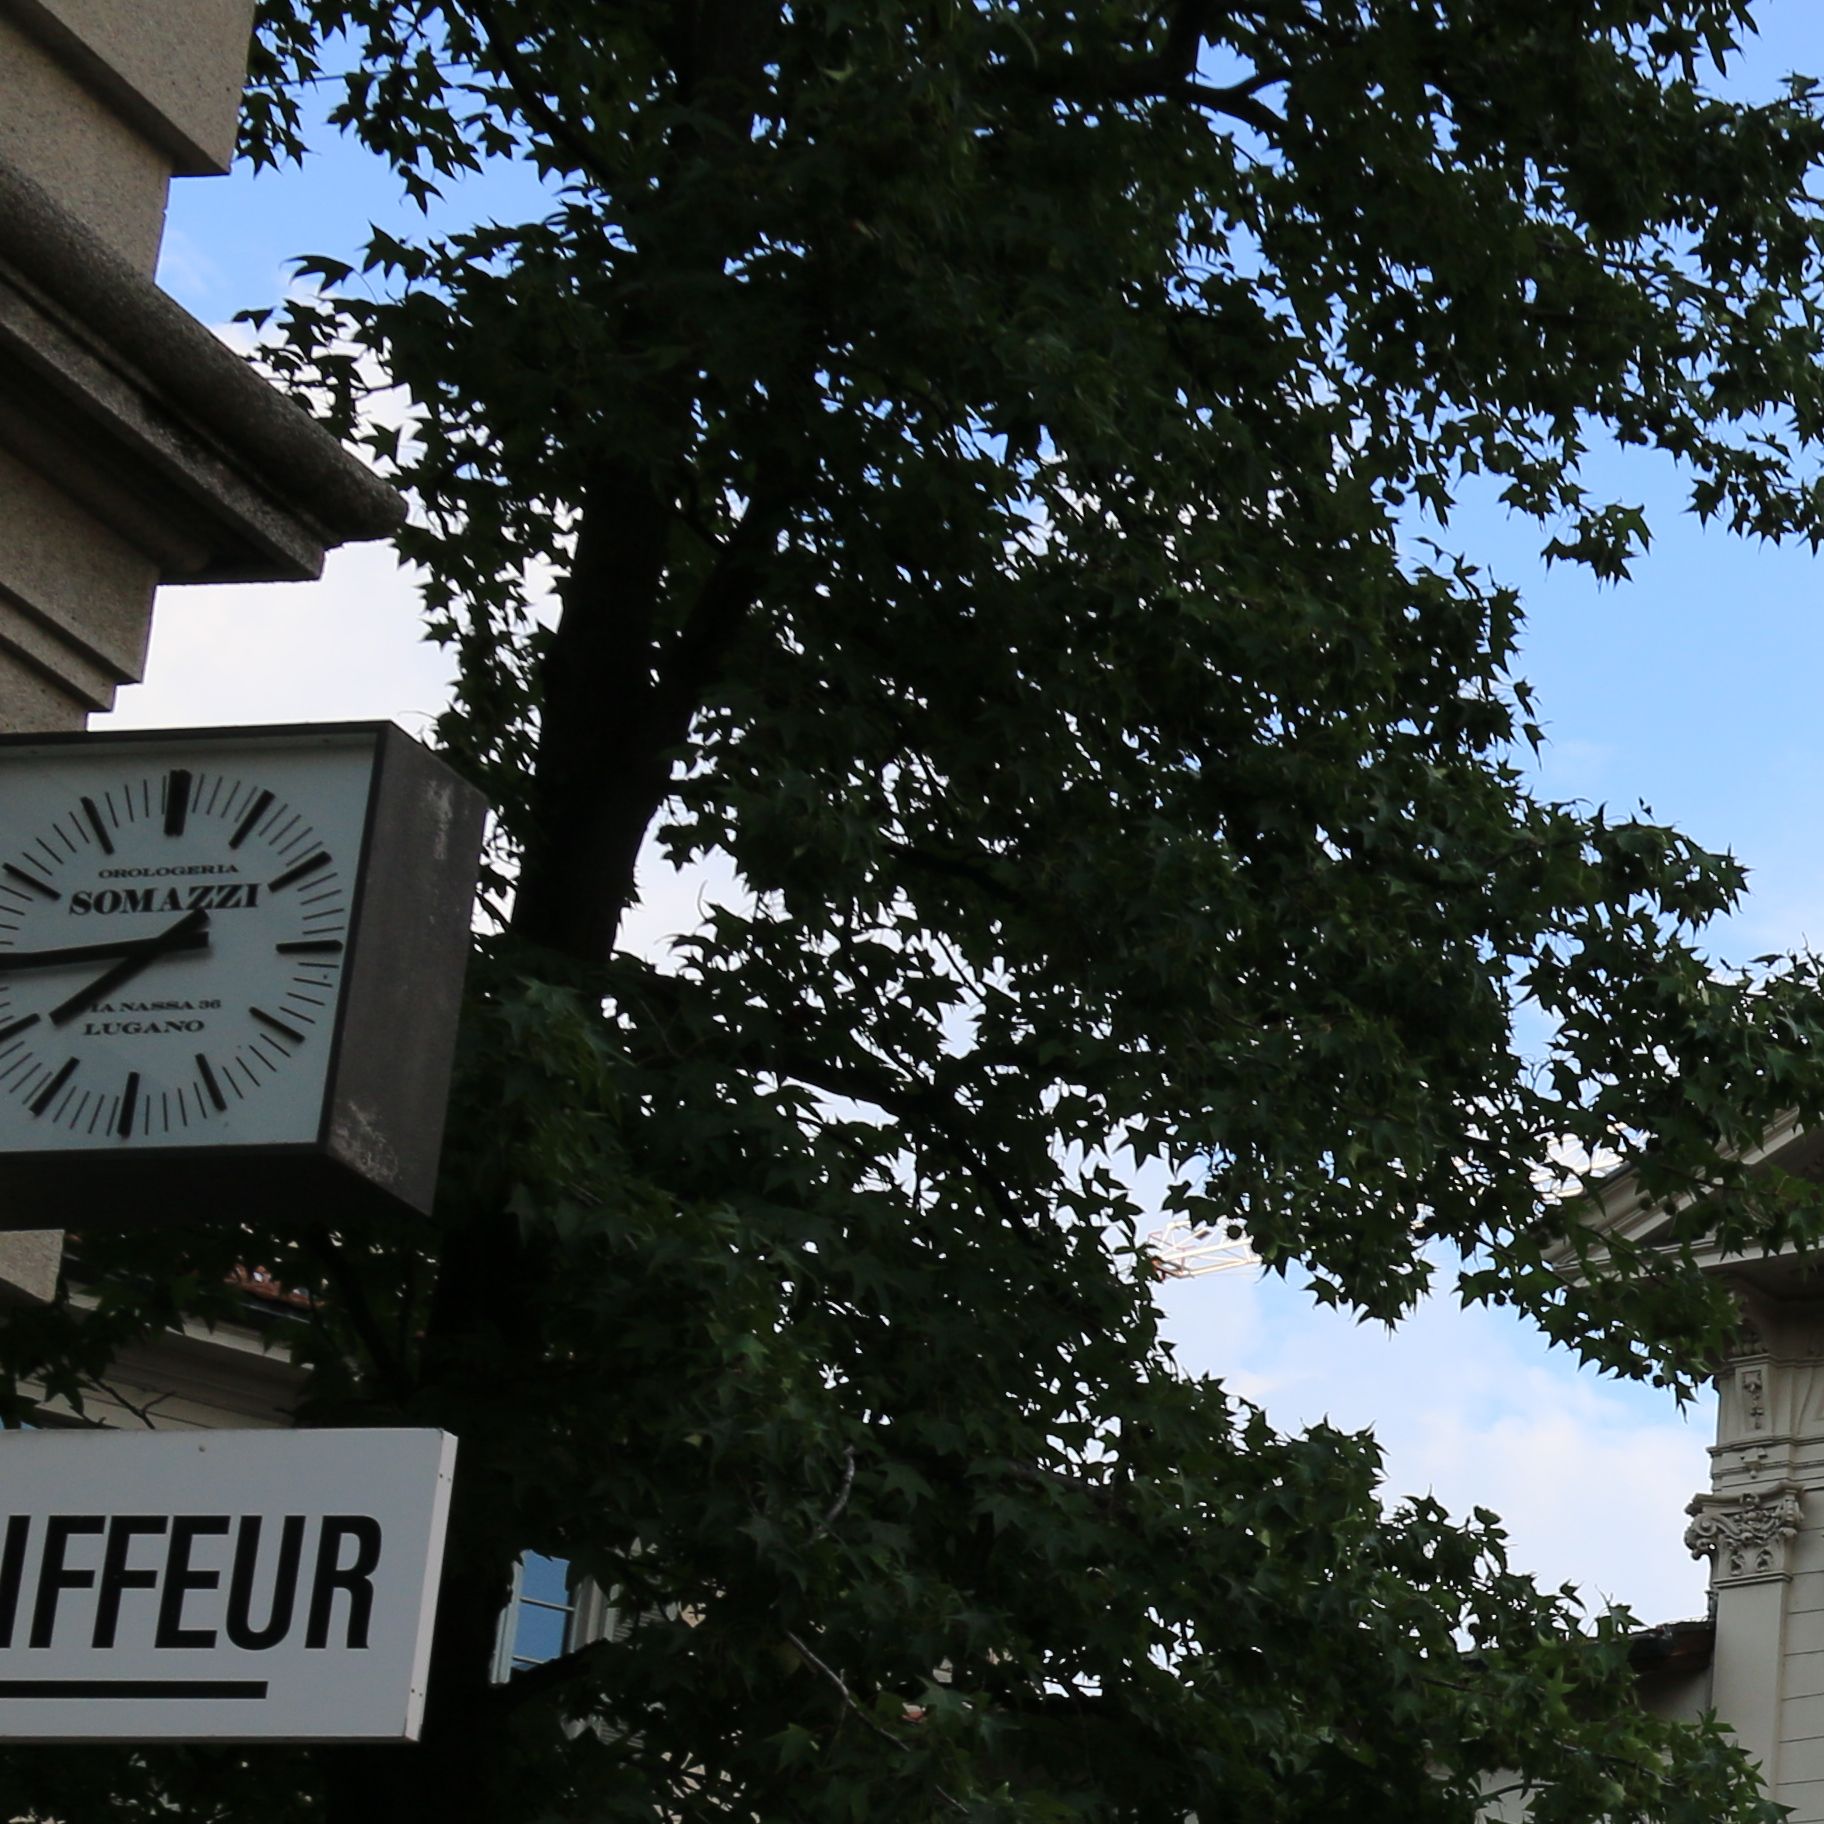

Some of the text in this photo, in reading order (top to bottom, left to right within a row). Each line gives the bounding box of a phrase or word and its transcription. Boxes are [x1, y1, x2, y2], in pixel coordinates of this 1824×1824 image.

[98, 864, 240, 879] OROLOGERIA
[68, 883, 261, 916] SOMAZZI
[86, 999, 222, 1013] IA NASSA 36
[83, 1019, 205, 1036] LUGANO
